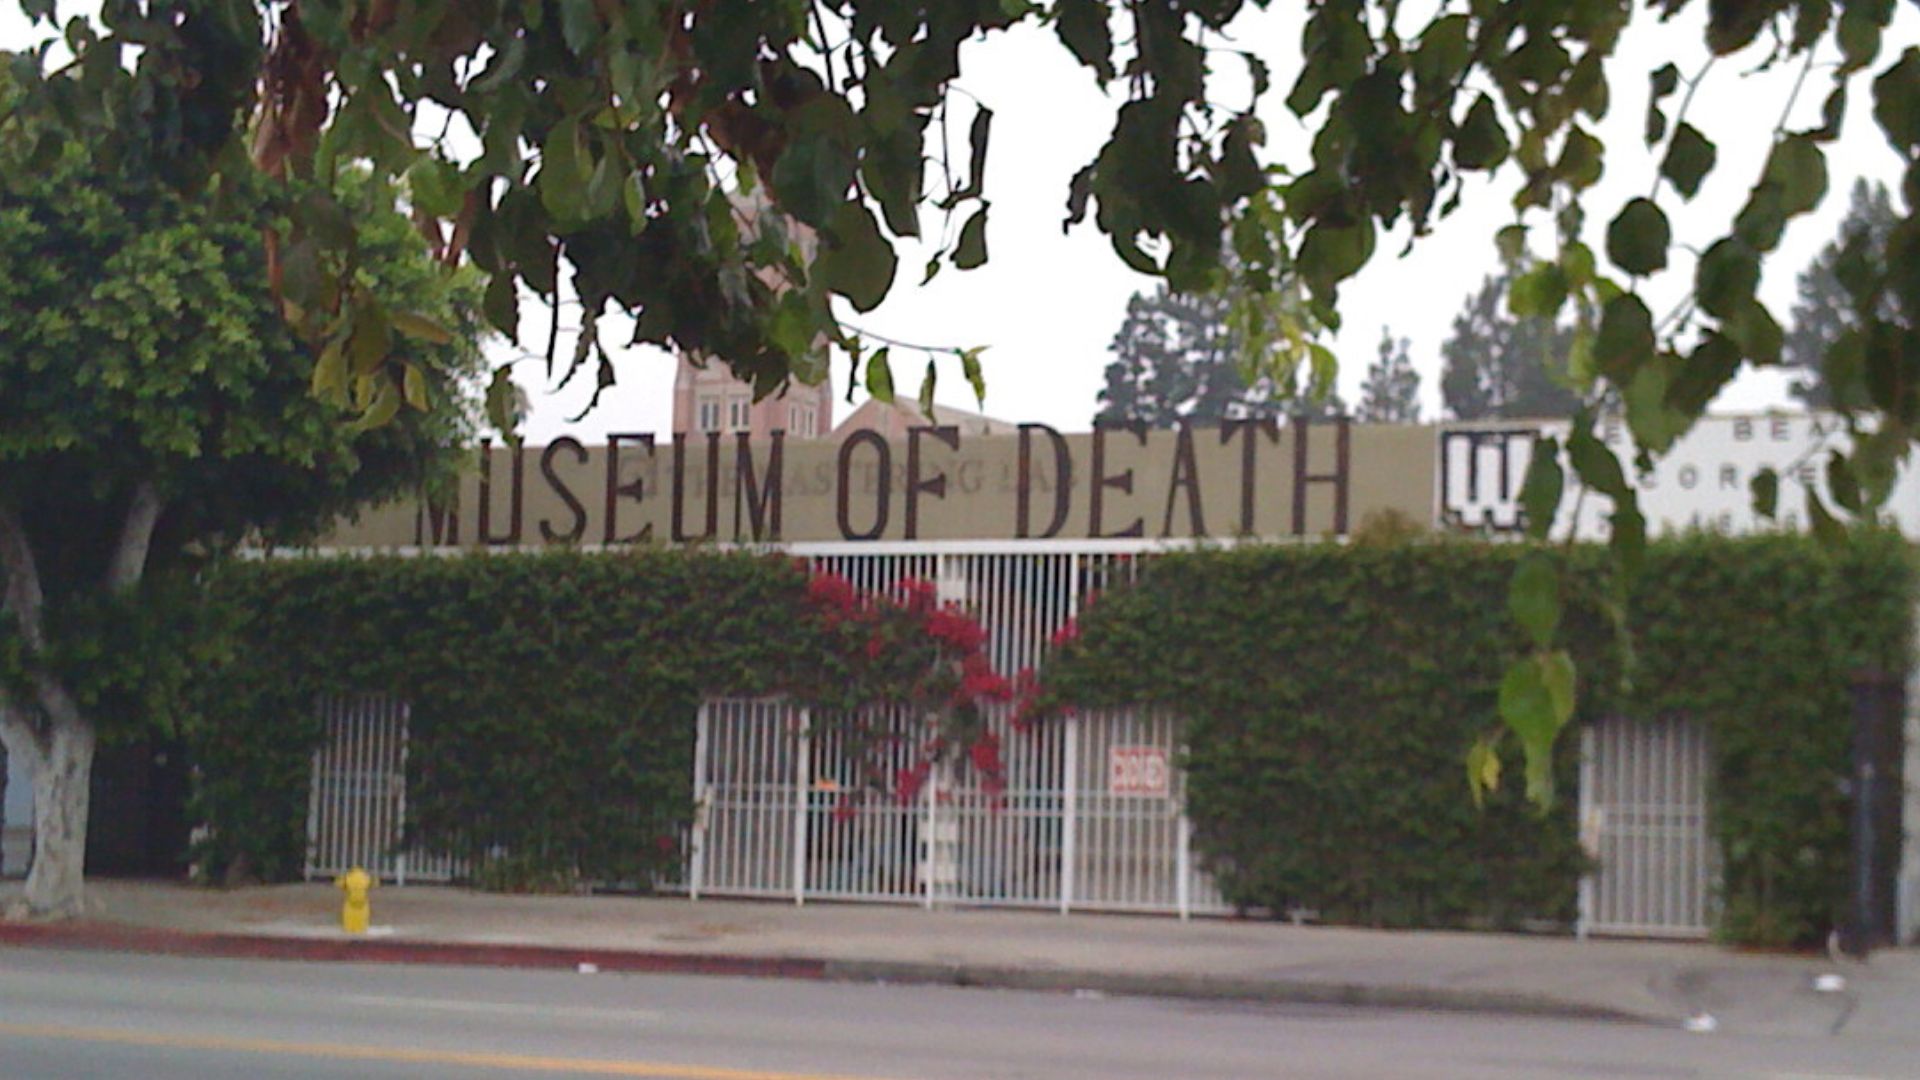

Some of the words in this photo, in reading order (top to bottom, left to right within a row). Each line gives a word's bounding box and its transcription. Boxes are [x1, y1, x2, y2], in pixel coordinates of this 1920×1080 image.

[415, 428, 786, 547] MUSEUM
[837, 427, 960, 541] OF
[1014, 415, 1351, 539] DEATH
